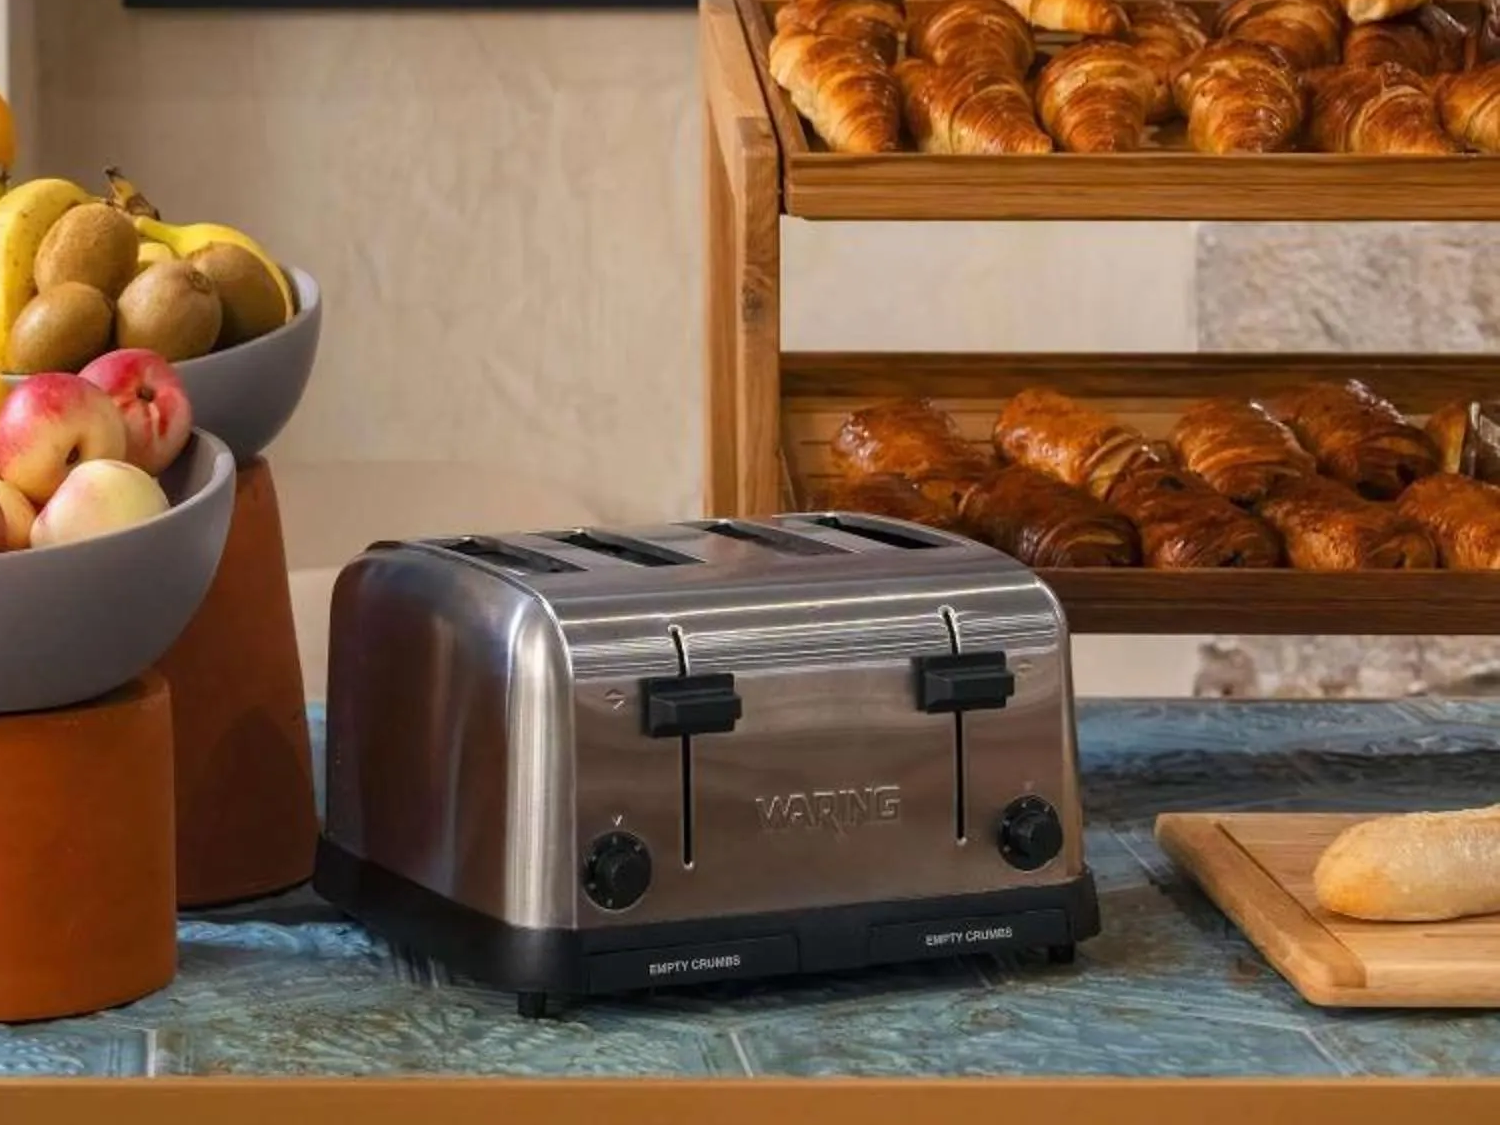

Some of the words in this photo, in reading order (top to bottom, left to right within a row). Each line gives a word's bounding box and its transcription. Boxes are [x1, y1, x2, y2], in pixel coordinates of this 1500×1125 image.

[755, 784, 901, 839] WARING
[925, 932, 963, 946] EMPTY
[965, 926, 1013, 943] CRUMBS
[648, 960, 689, 976] EMPTY
[691, 955, 741, 971] CRUMBS
